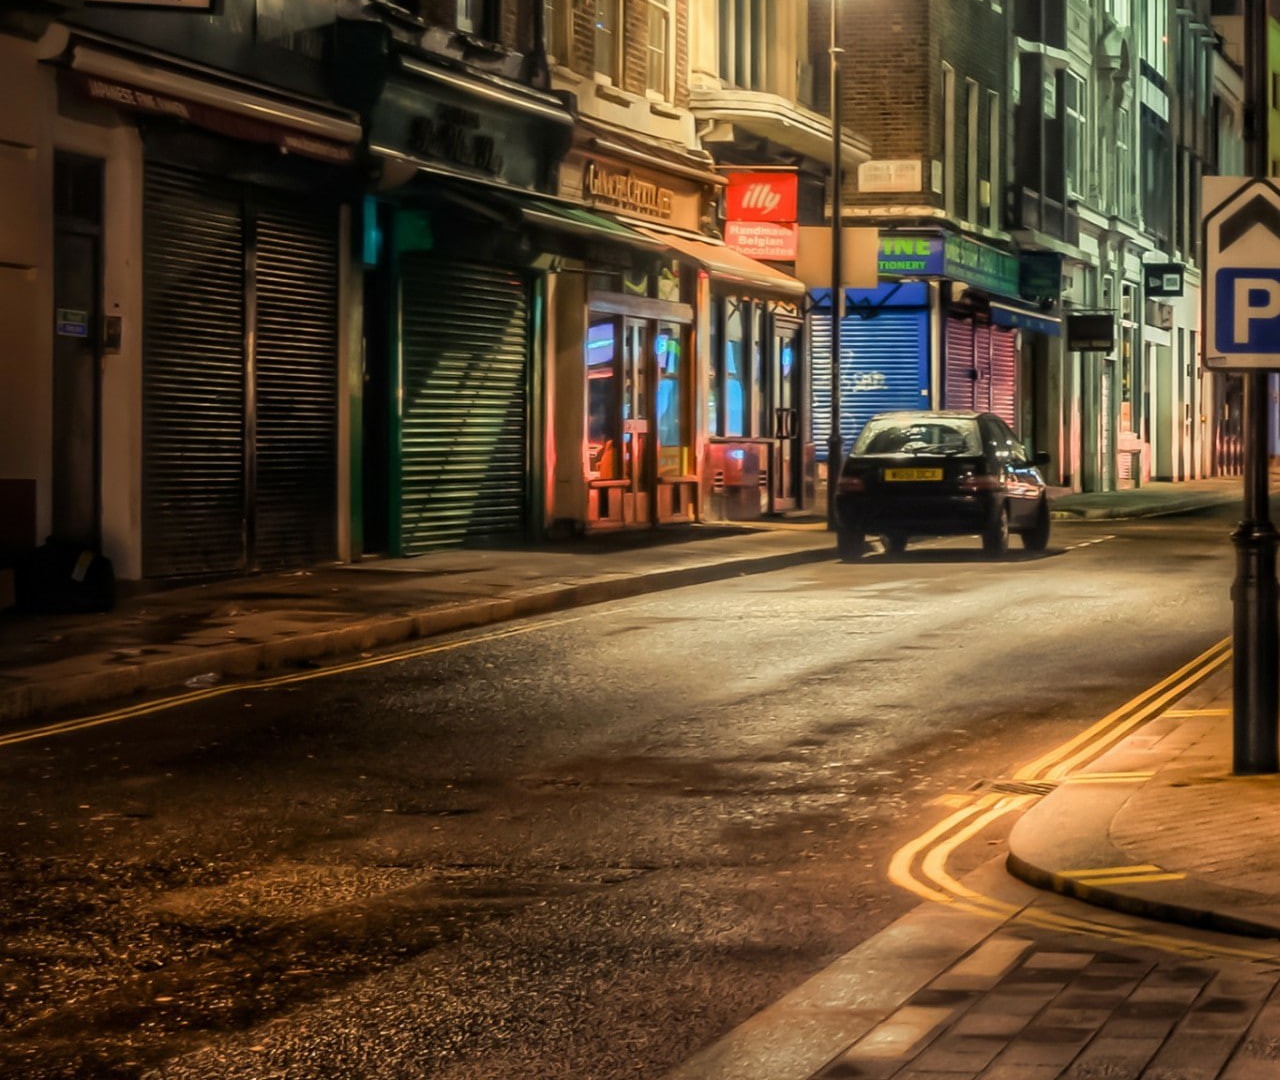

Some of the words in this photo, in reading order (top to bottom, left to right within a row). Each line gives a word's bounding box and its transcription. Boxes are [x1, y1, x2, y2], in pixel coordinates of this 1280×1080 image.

[741, 183, 782, 215] illy
[739, 235, 785, 247] Belgian
[883, 238, 931, 256] INE
[878, 260, 927, 270] TIONERY
